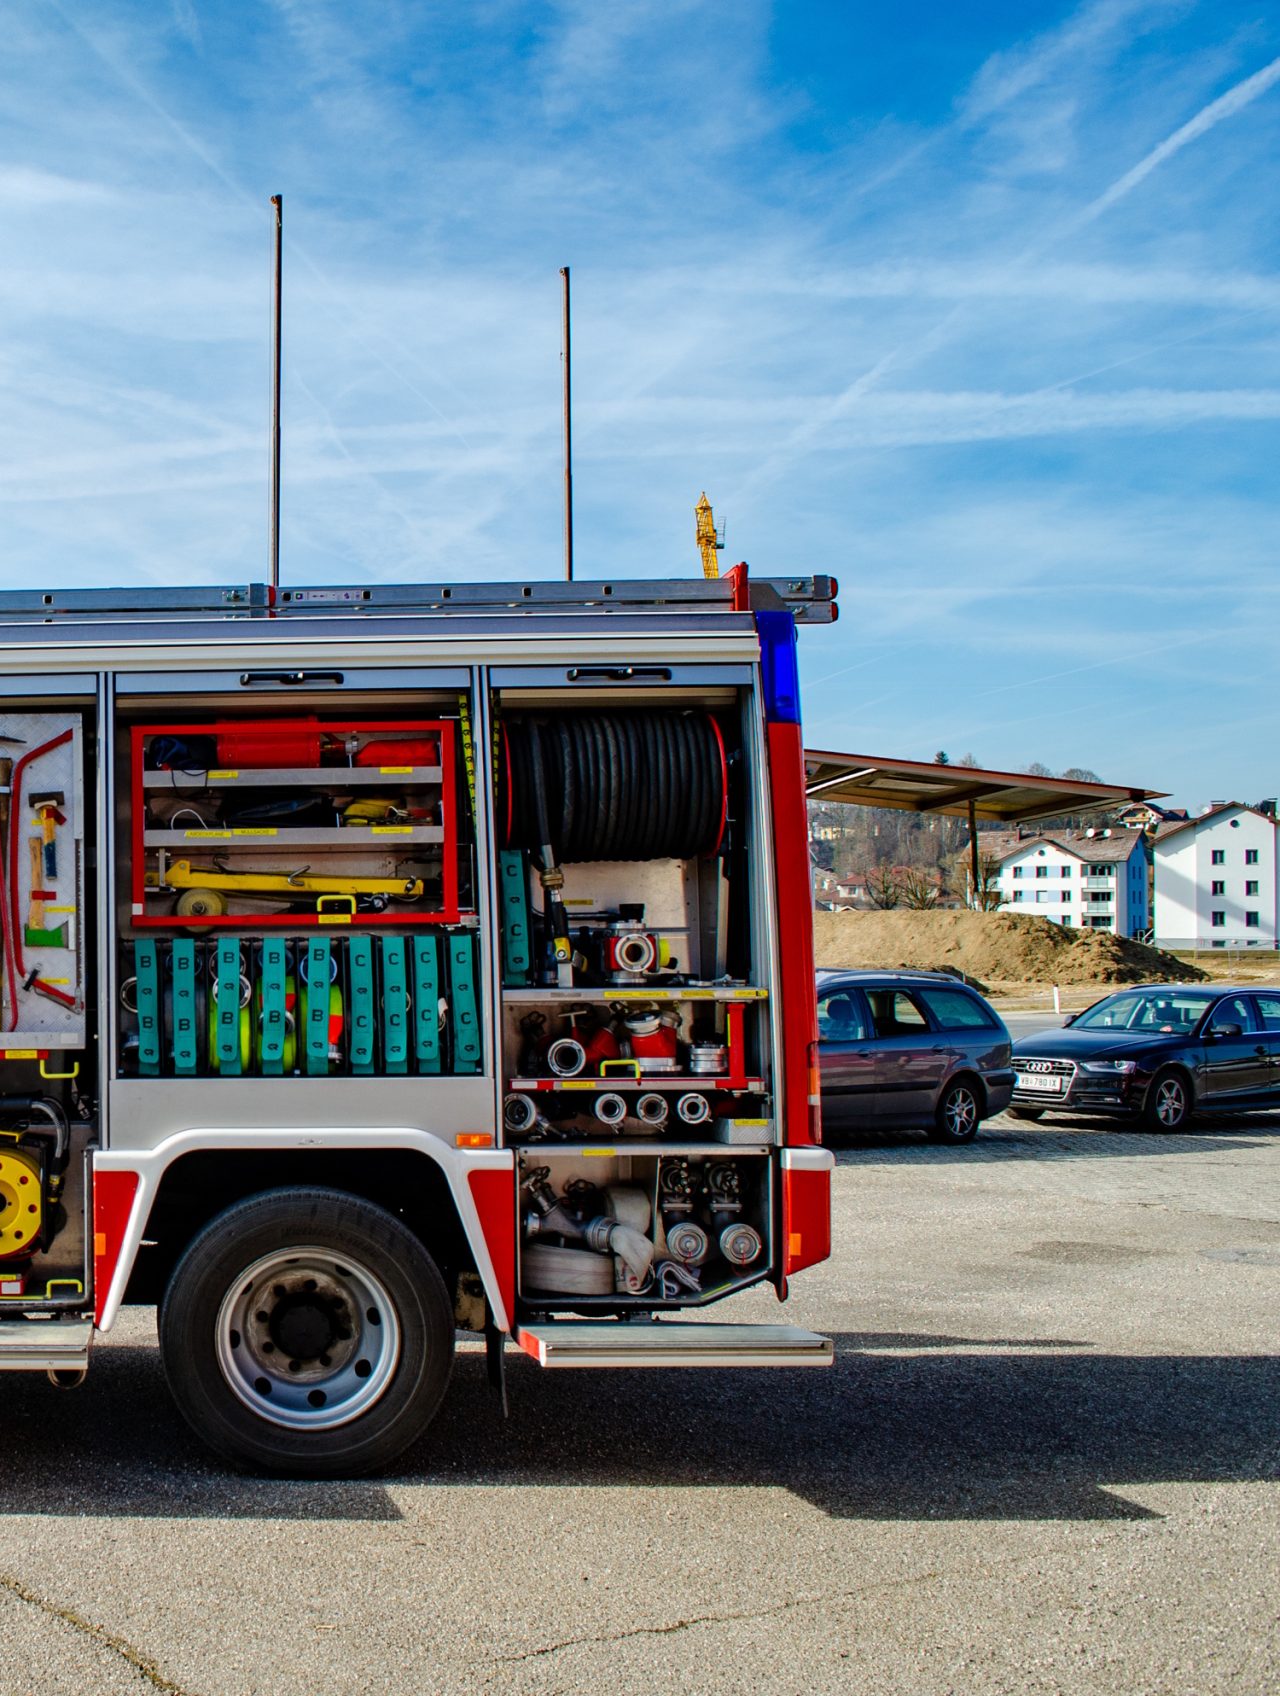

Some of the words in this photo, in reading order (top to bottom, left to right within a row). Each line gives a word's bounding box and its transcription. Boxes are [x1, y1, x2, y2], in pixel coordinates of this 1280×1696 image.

[506, 864, 518, 877] C
[511, 923, 522, 937] C
[223, 951, 235, 963] B
[269, 951, 281, 964] B
[313, 948, 325, 961] B
[355, 954, 366, 967] C
[388, 952, 399, 965] C
[420, 951, 431, 964] C
[456, 951, 466, 964] C
[140, 955, 152, 968] B
[178, 957, 190, 970] B
[222, 1011, 234, 1025] B
[269, 1010, 281, 1023] B
[312, 1009, 324, 1022] B
[356, 1015, 367, 1028] C
[390, 1013, 400, 1027] C
[421, 1009, 432, 1022] C
[460, 1012, 471, 1025] C
[143, 1016, 153, 1029] B
[179, 1018, 190, 1031] B
